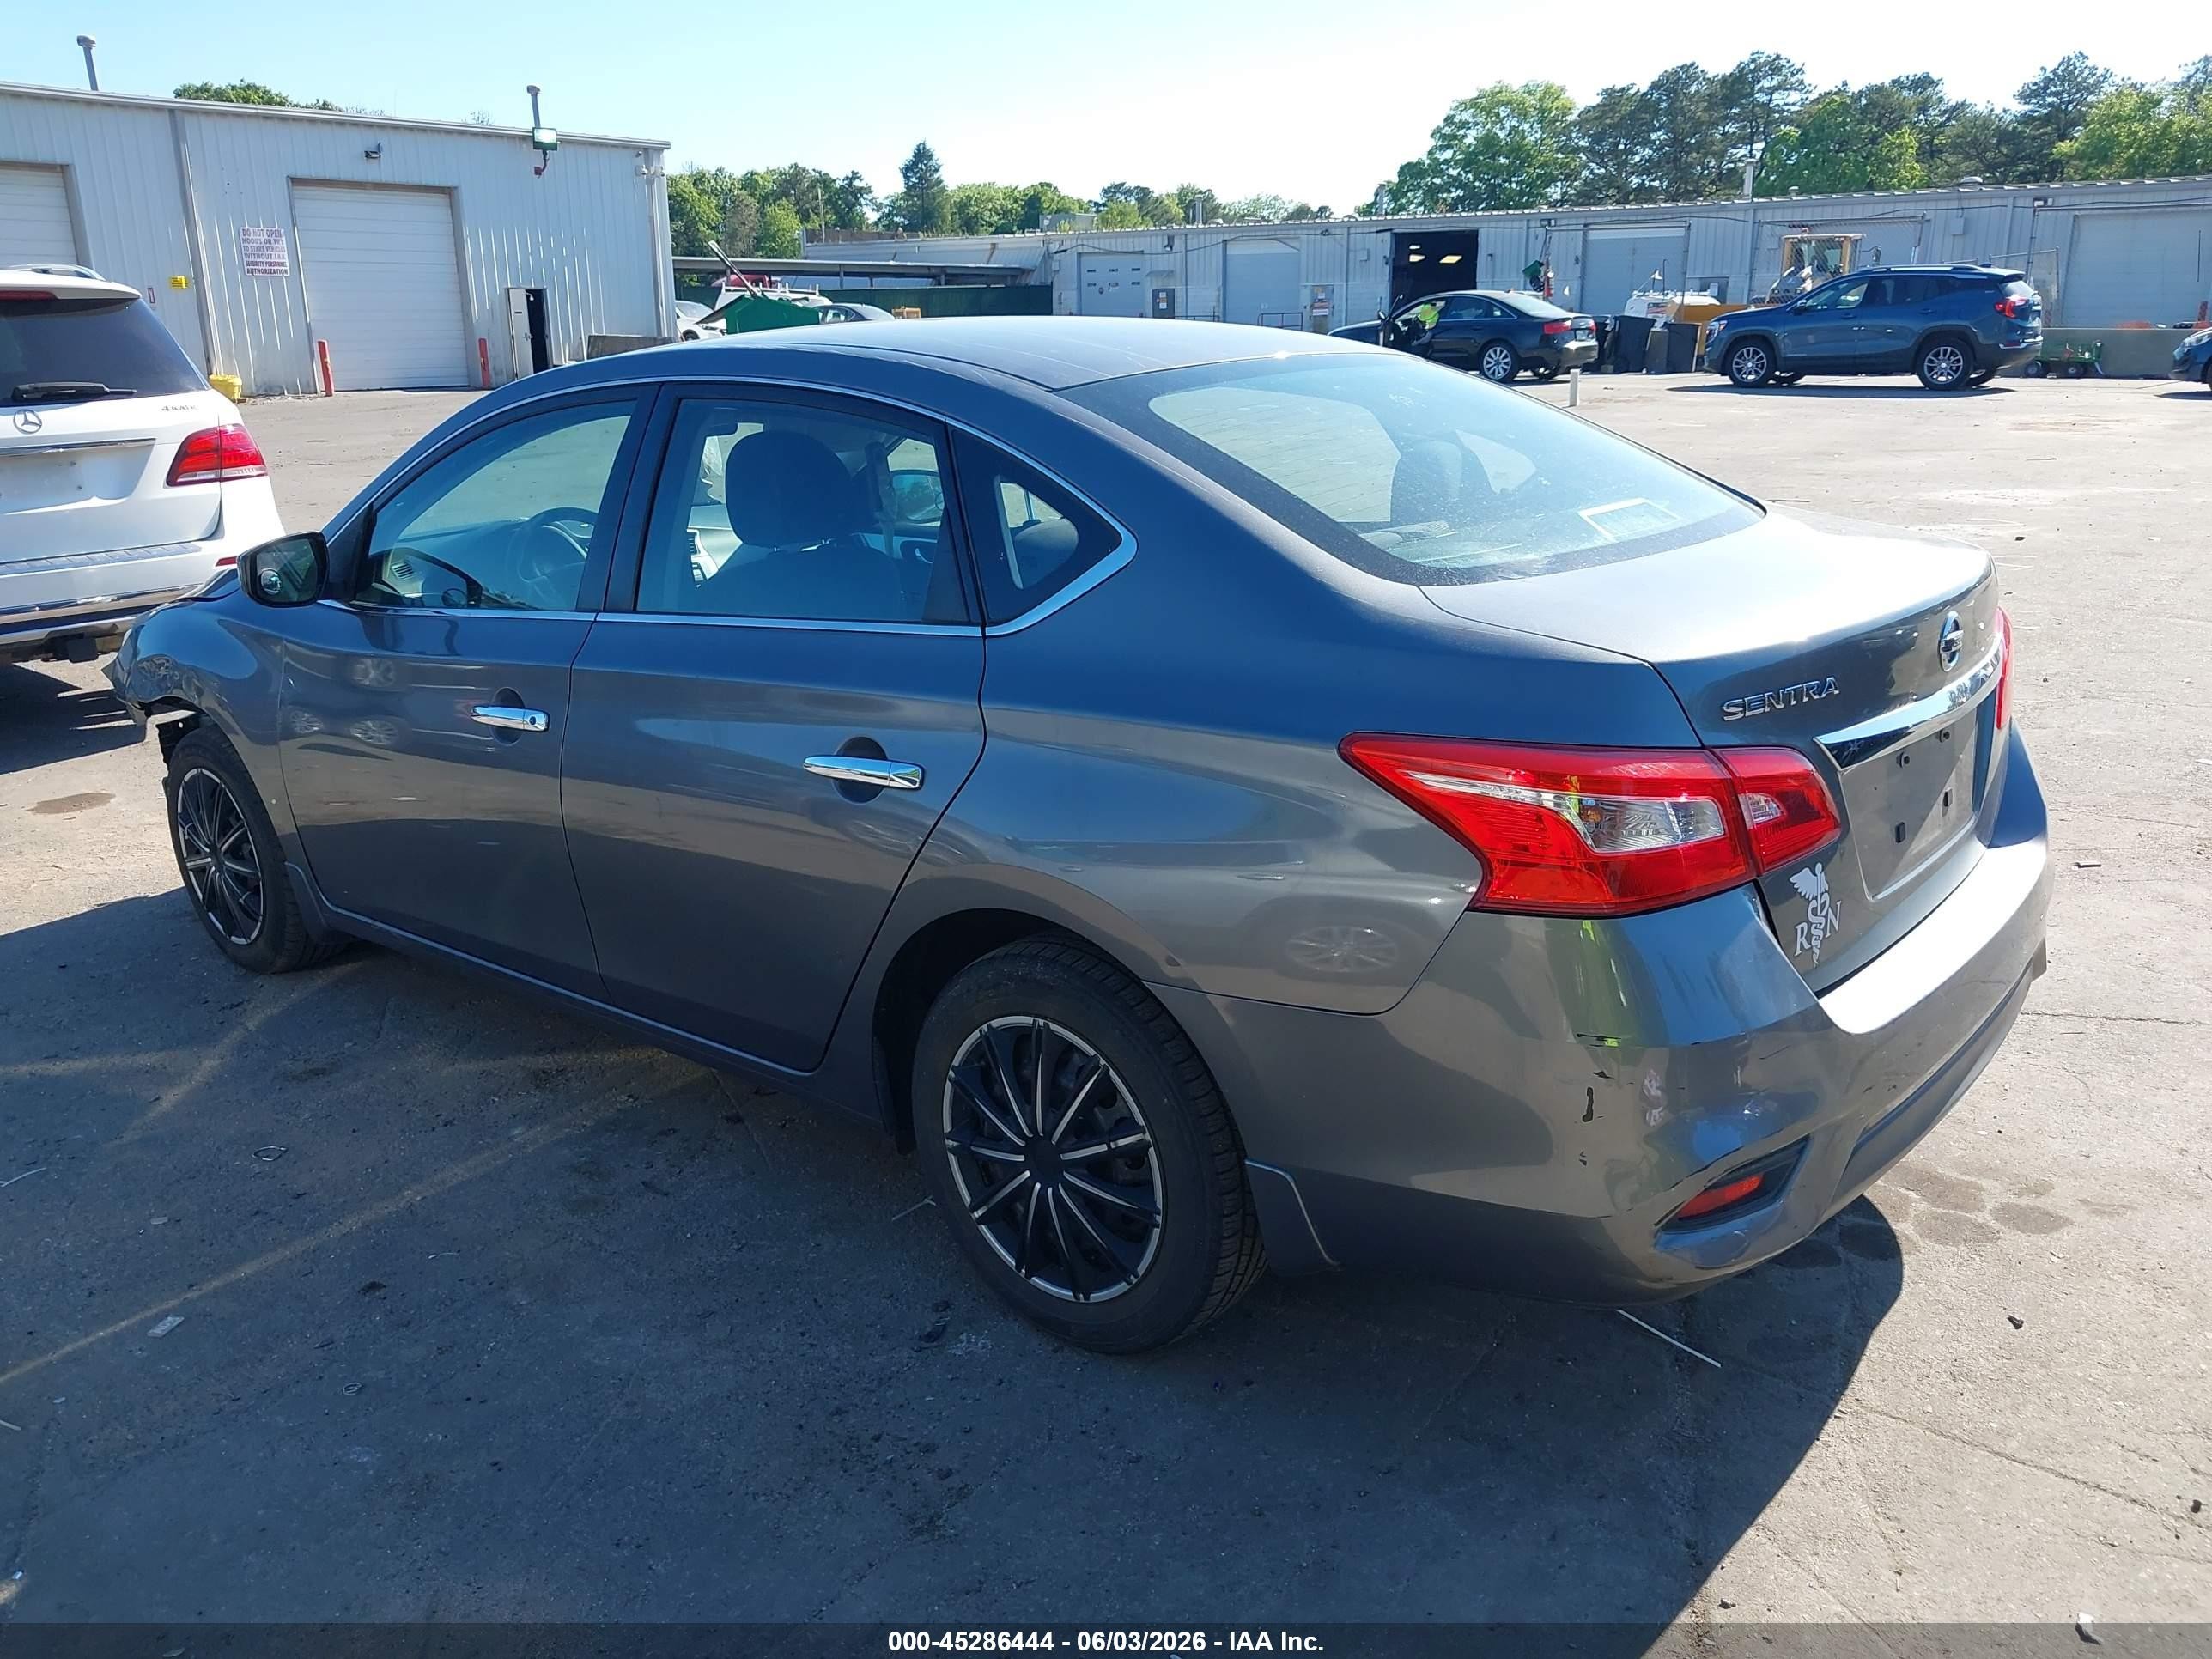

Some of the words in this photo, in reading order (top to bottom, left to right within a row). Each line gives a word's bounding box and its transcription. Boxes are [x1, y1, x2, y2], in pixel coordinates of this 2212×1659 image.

[242, 228, 251, 237] DO
[252, 228, 264, 237] NOT
[266, 228, 282, 238] OPEN
[1722, 677, 1840, 721] SENTRA
